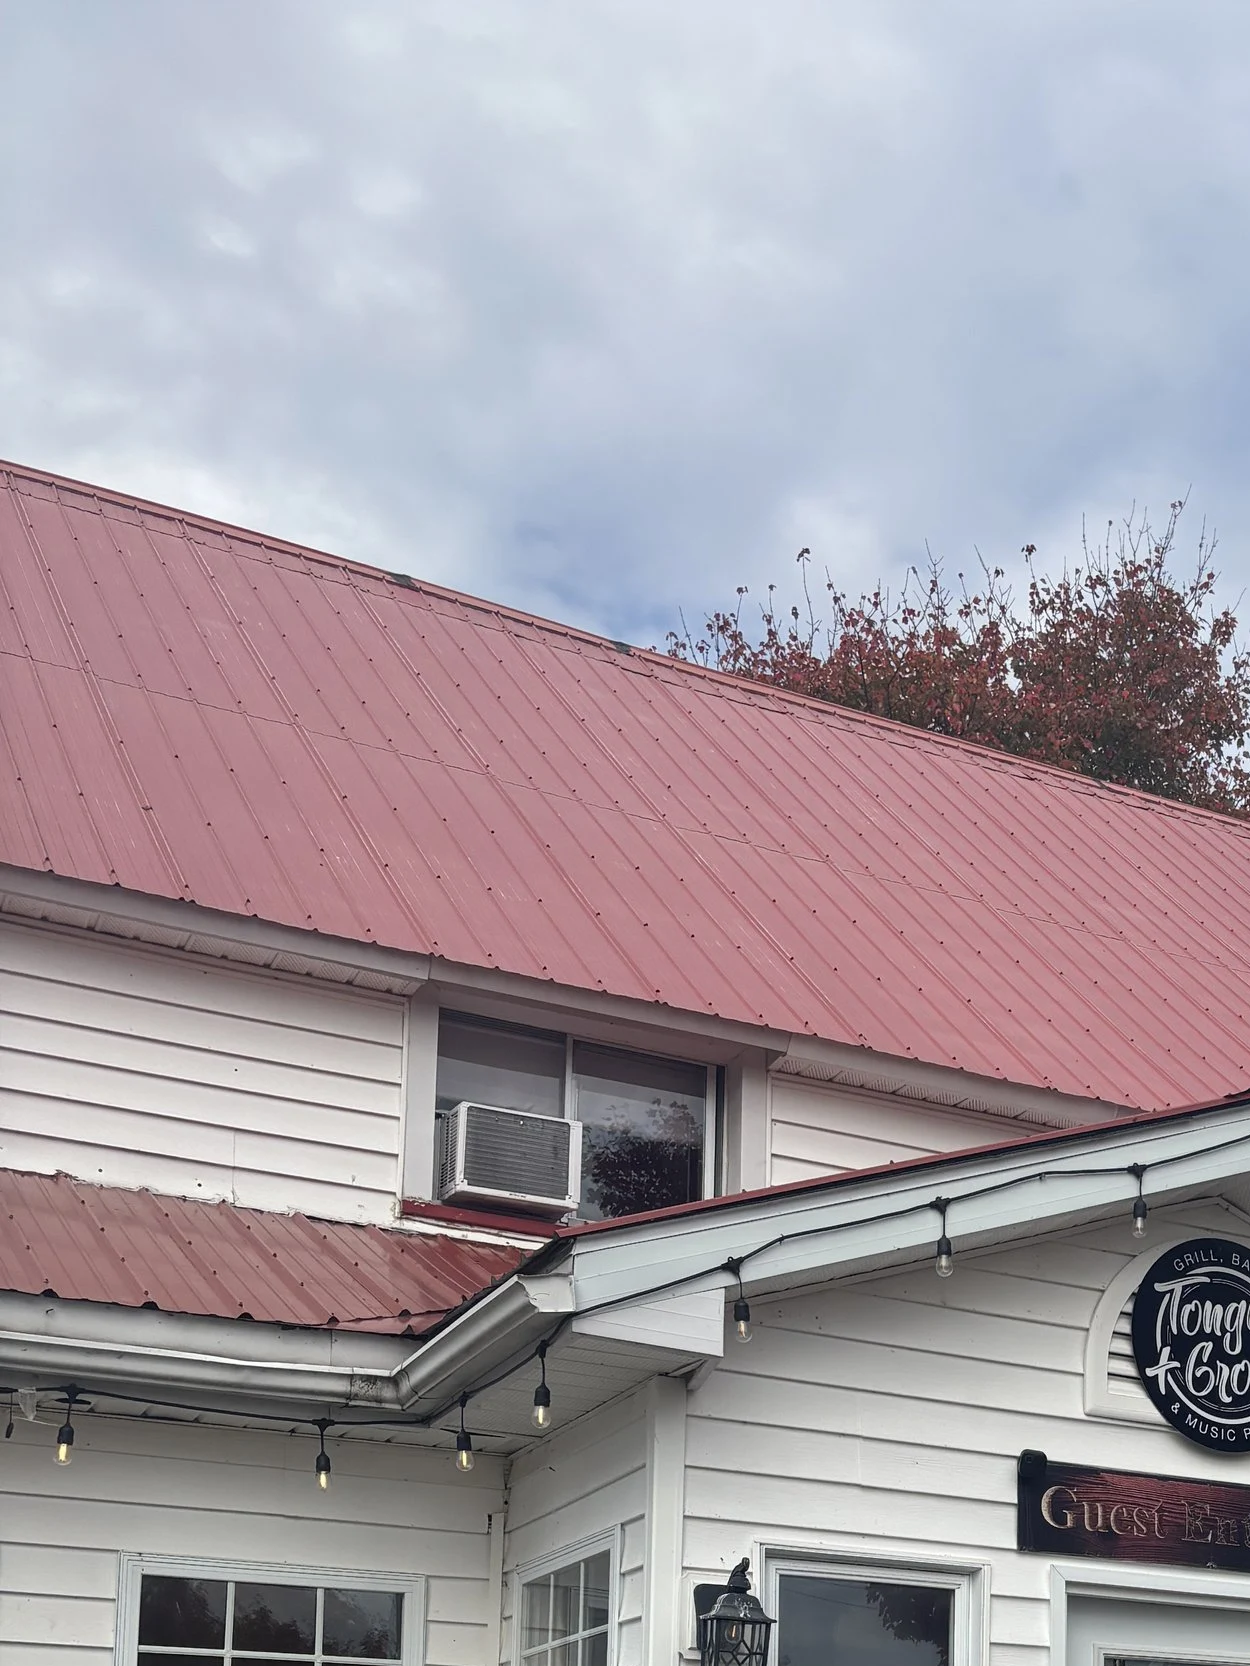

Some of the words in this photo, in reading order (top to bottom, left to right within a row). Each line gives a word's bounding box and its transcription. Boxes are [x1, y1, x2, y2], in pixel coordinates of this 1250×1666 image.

[1173, 1249, 1224, 1273] GRILL,
[1170, 1402, 1181, 1416] &
[1184, 1413, 1237, 1442] MUSIC
[1040, 1485, 1170, 1539] Guest
